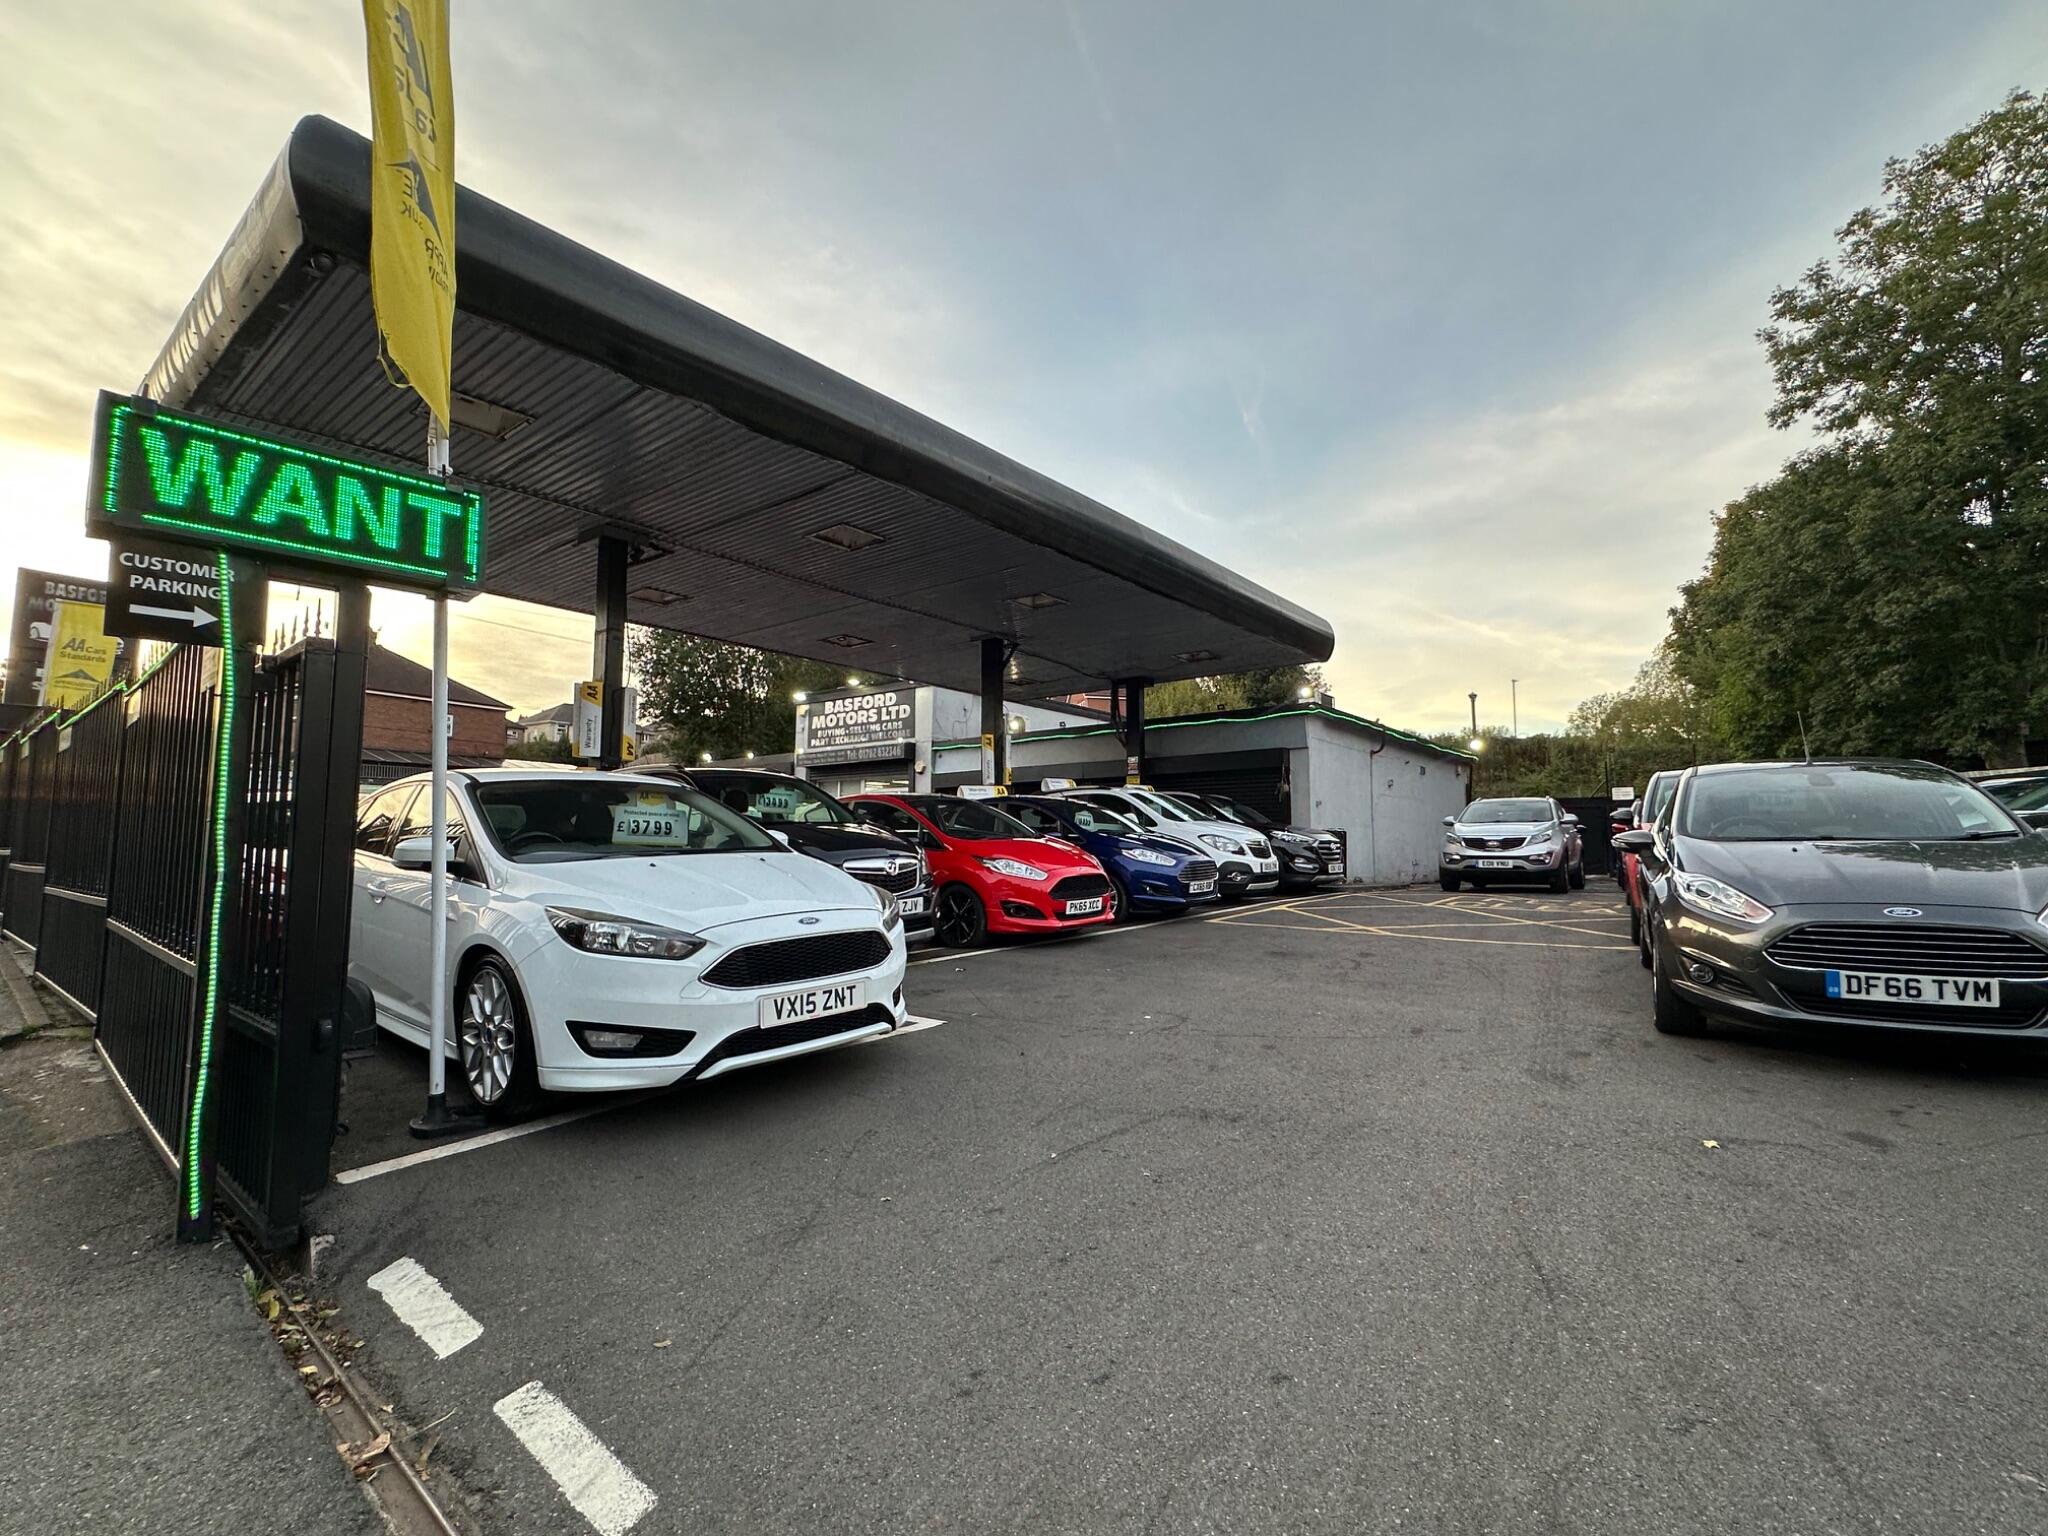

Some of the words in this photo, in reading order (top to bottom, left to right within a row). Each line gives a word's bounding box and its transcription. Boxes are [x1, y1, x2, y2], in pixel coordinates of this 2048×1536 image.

[139, 425, 461, 559] WANT
[44, 581, 107, 602] BASFO
[129, 574, 223, 600] PARKING
[62, 637, 86, 652] AA
[60, 650, 106, 663] Standards
[586, 685, 598, 700] AA
[824, 692, 897, 714] BASFORD
[812, 708, 878, 729] MOTORS
[881, 704, 911, 721] LTD
[583, 718, 594, 749] Warranty
[817, 727, 845, 738] BUYING
[849, 723, 881, 734] SELLING
[882, 721, 903, 730] CARS
[811, 737, 829, 746] PART
[902, 898, 918, 913] ZJV
[1070, 900, 1088, 912] PK65
[1088, 899, 1100, 910] XCC
[1845, 974, 1922, 999] DF66
[1932, 978, 1993, 1003] TVM
[773, 992, 817, 1020] VX15
[822, 985, 857, 1011] ZNT
